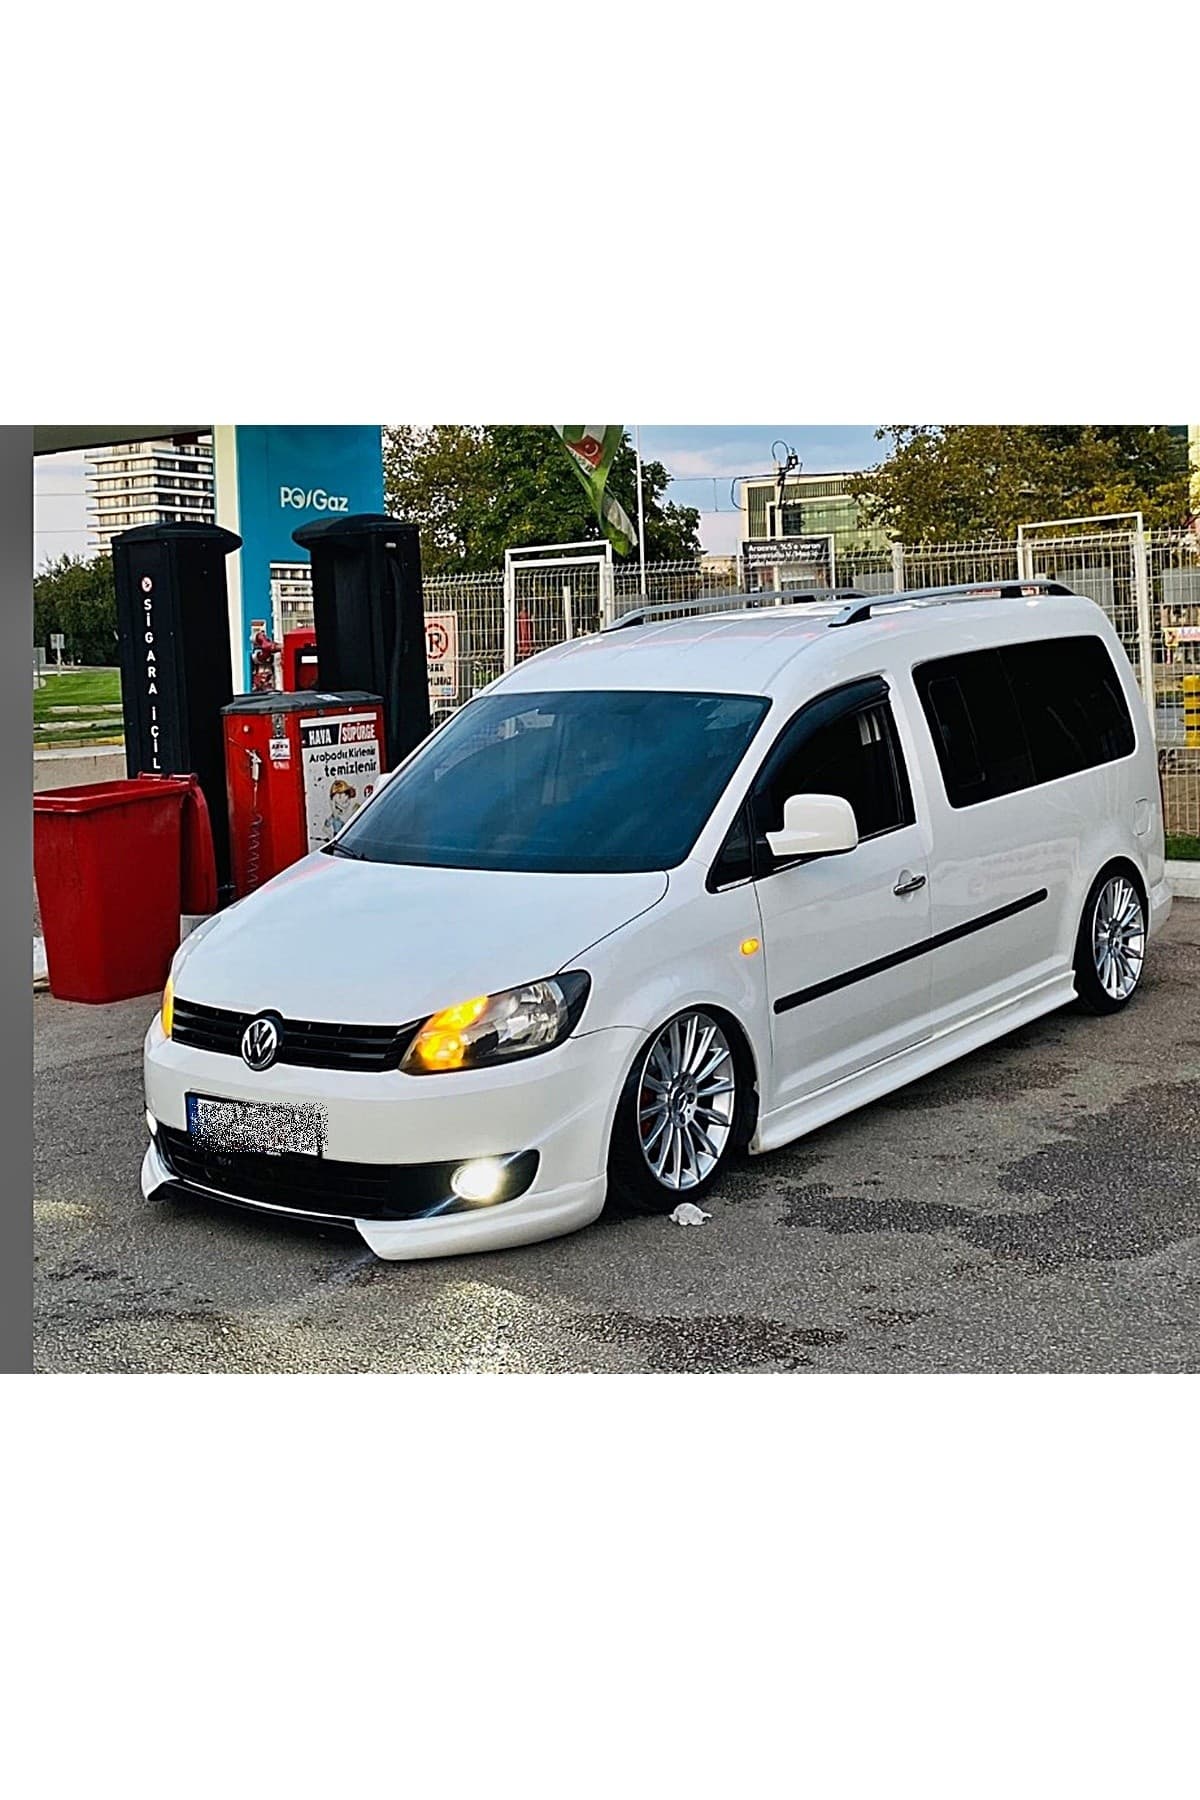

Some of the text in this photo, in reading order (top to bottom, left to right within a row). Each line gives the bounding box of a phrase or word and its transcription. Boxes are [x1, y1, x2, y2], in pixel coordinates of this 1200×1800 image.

[143, 598, 158, 695] SİGARA
[308, 722, 376, 746] HAVA SÜPÜRGE
[324, 759, 377, 777] temizlenir
